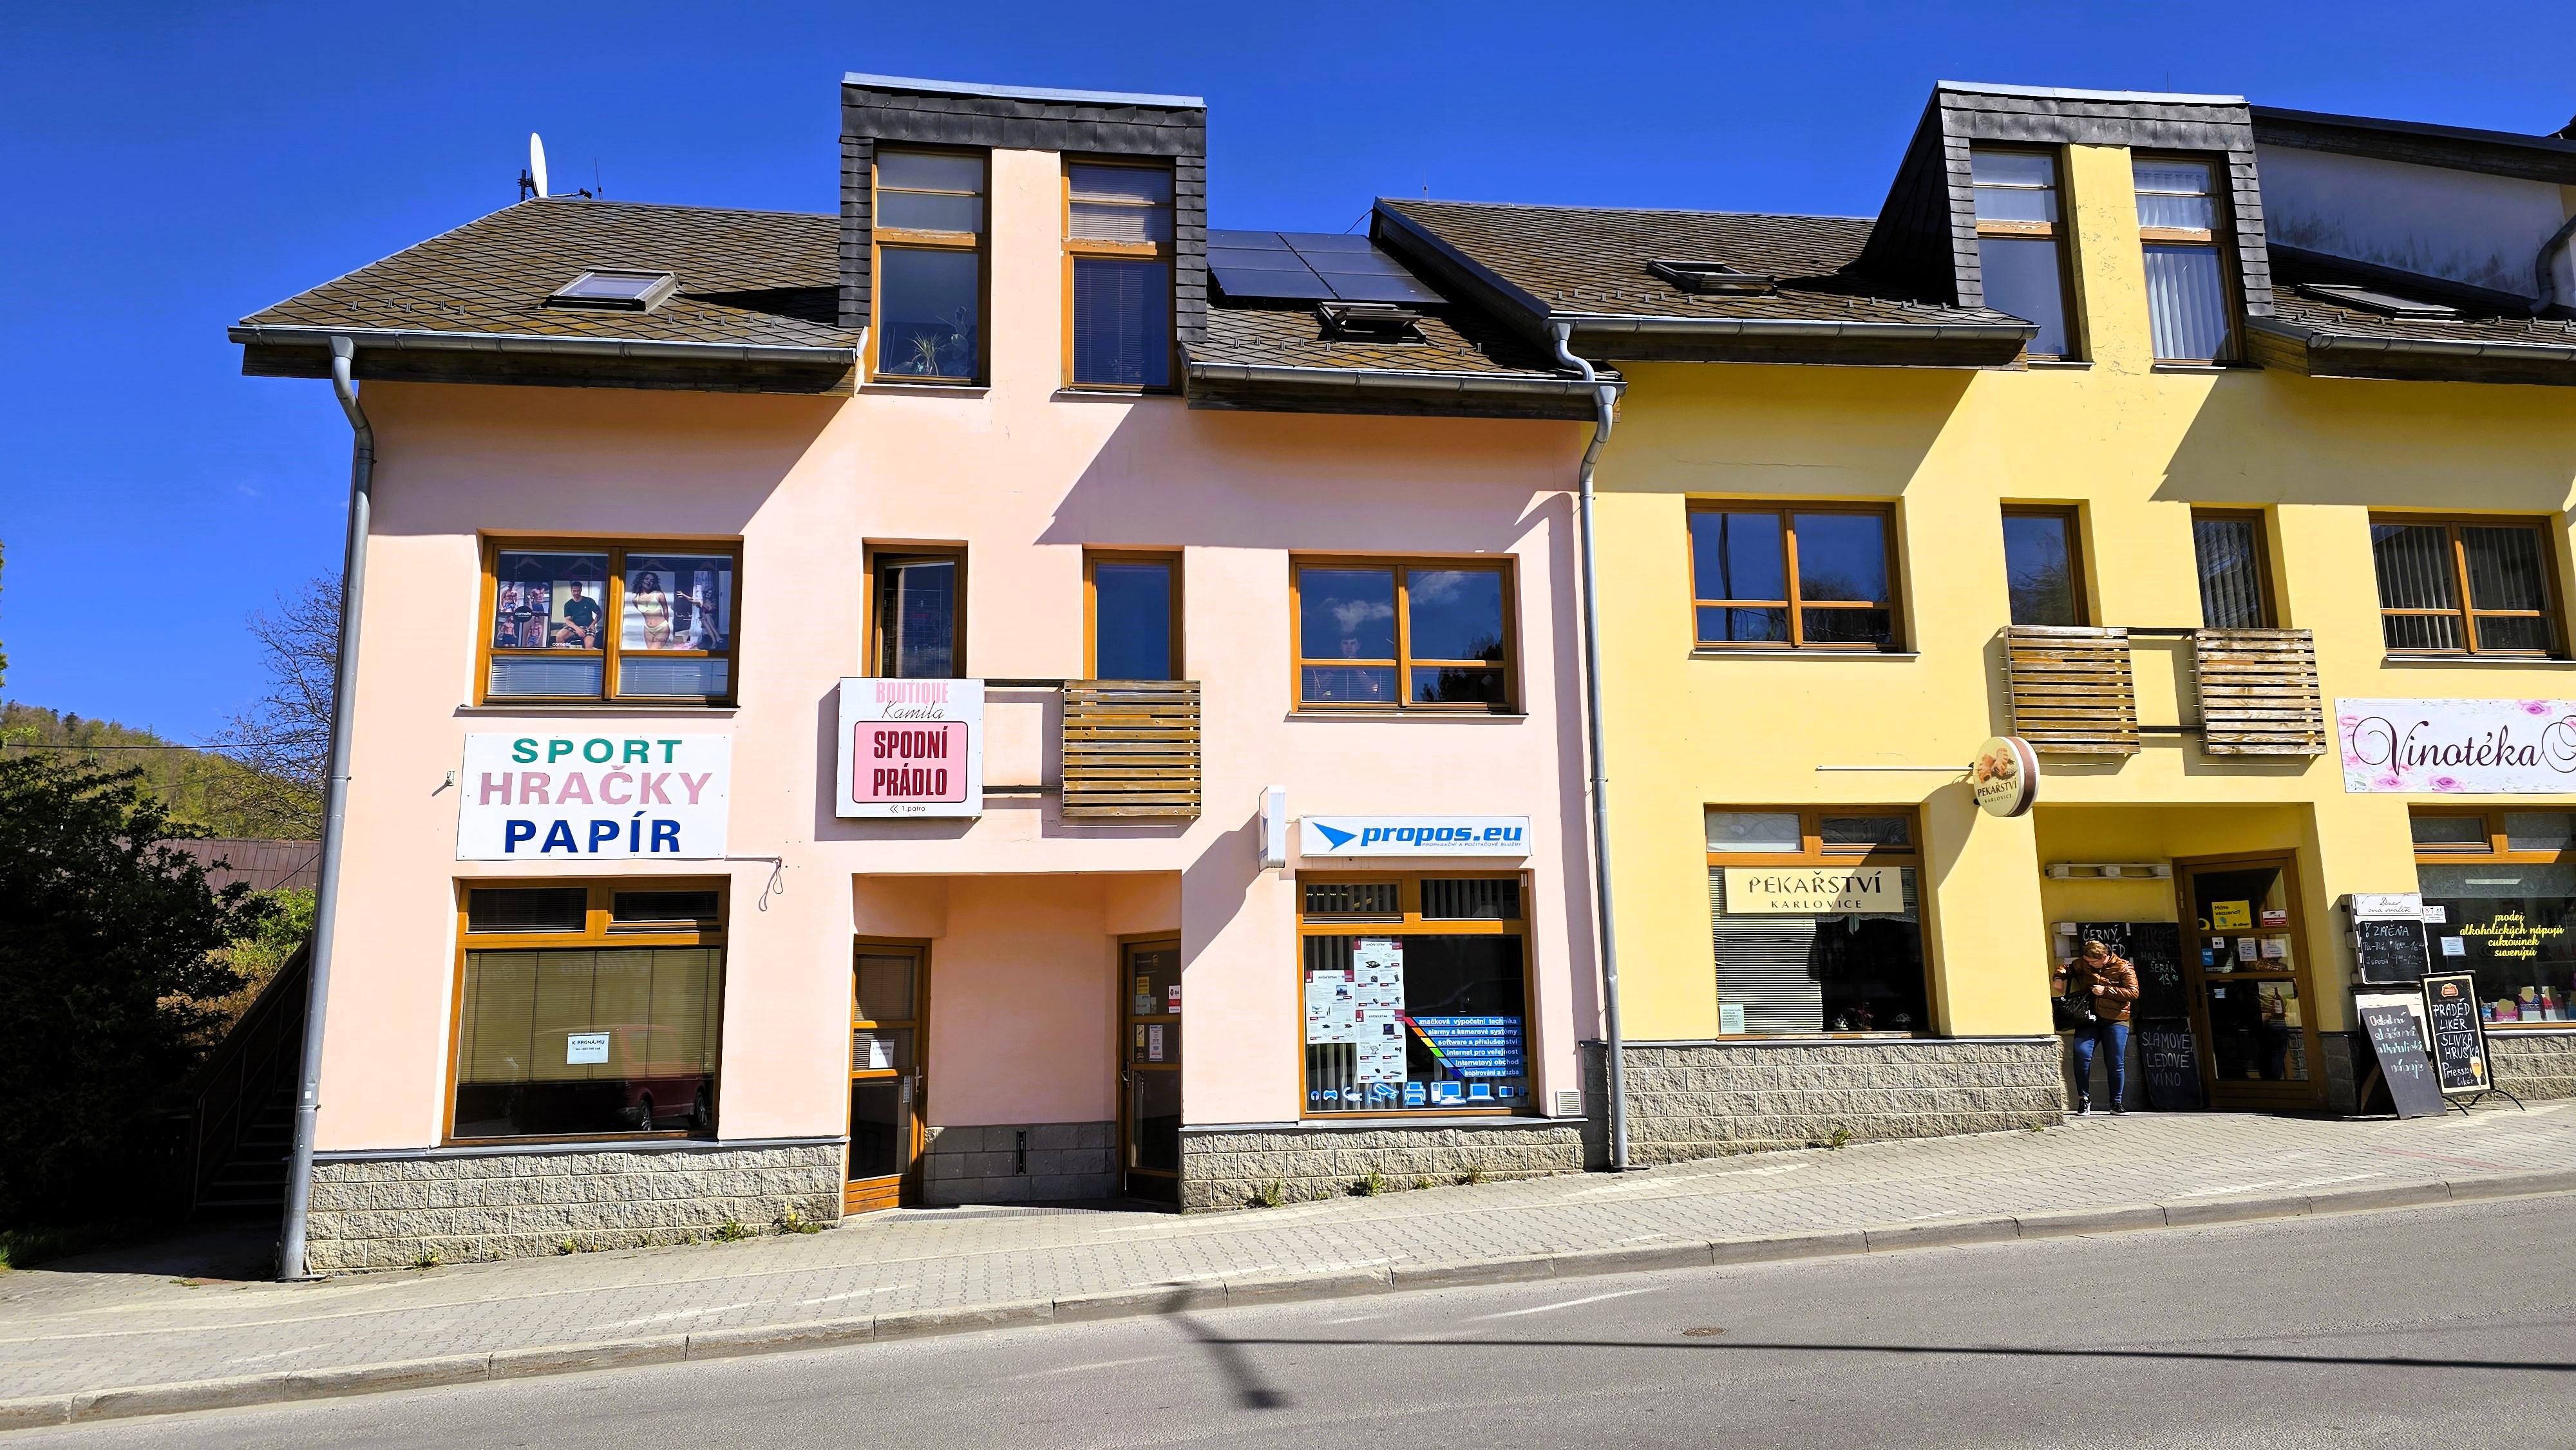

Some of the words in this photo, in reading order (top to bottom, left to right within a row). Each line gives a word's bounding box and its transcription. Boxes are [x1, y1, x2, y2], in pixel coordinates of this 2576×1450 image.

[876, 682, 949, 704] BOUTIQUE
[881, 701, 945, 719] Kamila
[511, 738, 682, 764] SPORT
[874, 726, 948, 758] SPODNÍ
[2352, 717, 2543, 777] Vinotéka
[479, 765, 713, 805] HRAČKY
[873, 763, 947, 796] PRÁDLO
[1978, 777, 2017, 797] PEKAŘSTVÍ
[504, 811, 681, 854] PAPÍR
[1360, 827, 1522, 847] propos.eu
[1748, 871, 1882, 894] PEKAŘSTVÍ
[1772, 900, 1861, 909] KARLOVICE
[2495, 910, 2526, 925] prodej
[2083, 924, 2119, 941] ČERNÝ
[2459, 923, 2528, 939] alkoholických
[2530, 925, 2565, 938] nápojů
[2488, 934, 2540, 946] cukrovinek
[2494, 946, 2537, 961] suvenýrů
[2150, 961, 2177, 973] ŠERÁK
[2439, 1015, 2467, 1031] LIKÉR
[1475, 1038, 1518, 1046] příslušenství
[2142, 1024, 2190, 1049] SLÁMOVÉ
[2440, 1032, 2473, 1047] SLIVKA
[2146, 1050, 2190, 1068] LEDOVÉ
[1464, 1069, 1495, 1077] kopírování
[2152, 1068, 2181, 1087] VÍNO
